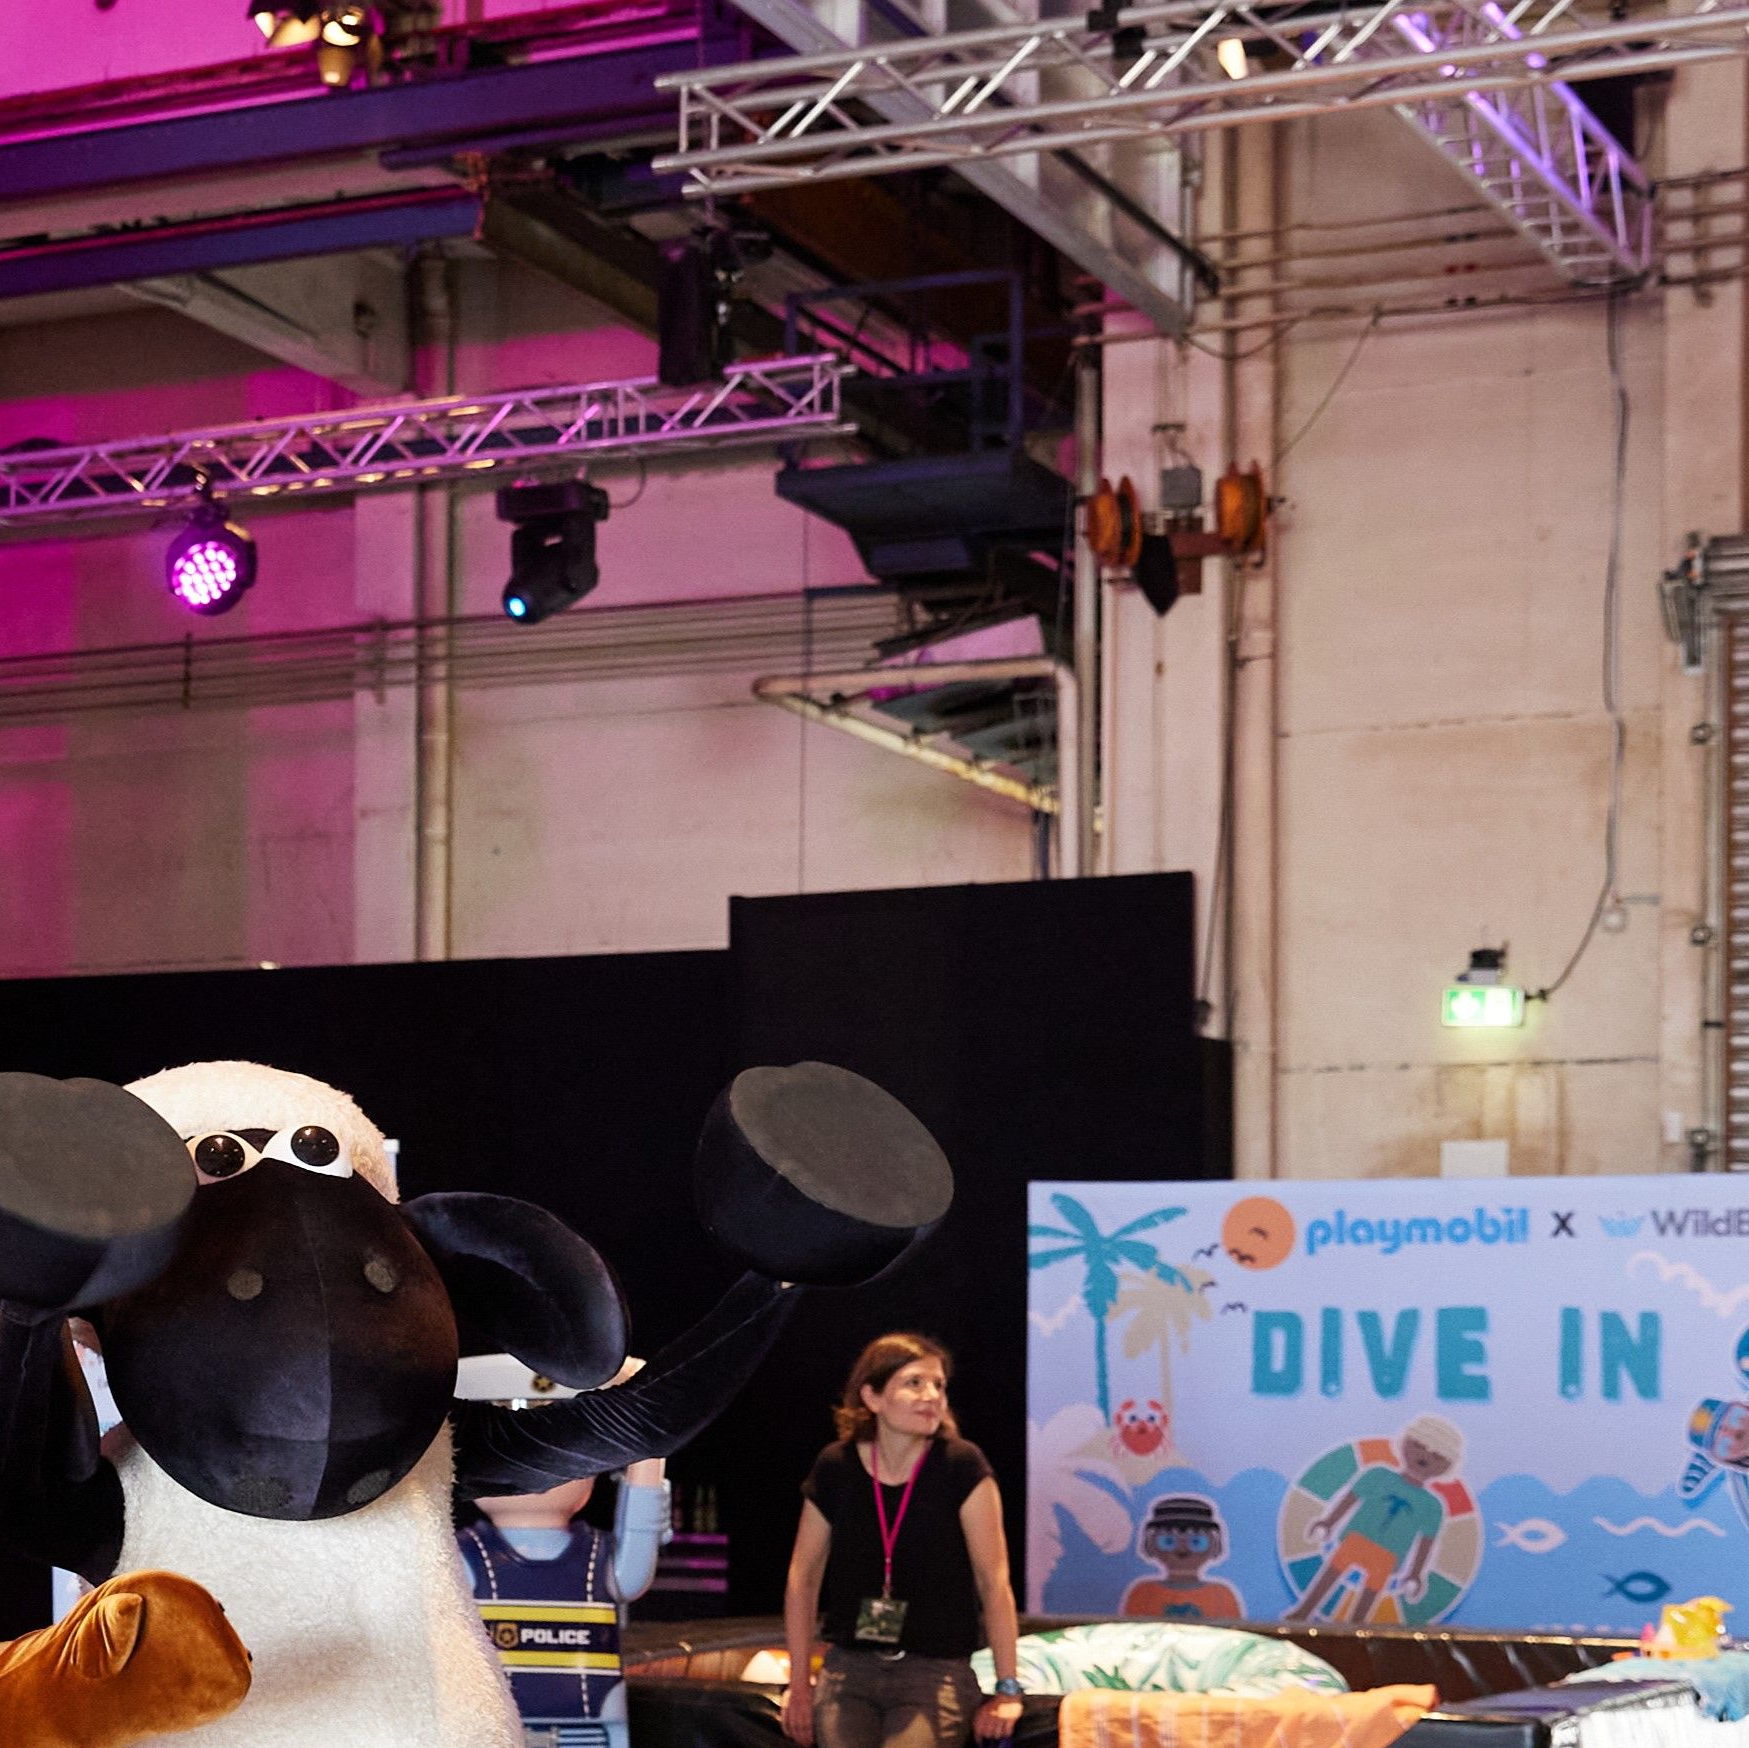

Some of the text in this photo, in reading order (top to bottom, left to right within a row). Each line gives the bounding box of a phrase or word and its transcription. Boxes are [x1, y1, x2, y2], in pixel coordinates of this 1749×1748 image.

[1307, 1207, 1529, 1254] playmobil
[1252, 1306, 1662, 1402] DIVE IN
[520, 1628, 590, 1644] POLICE
